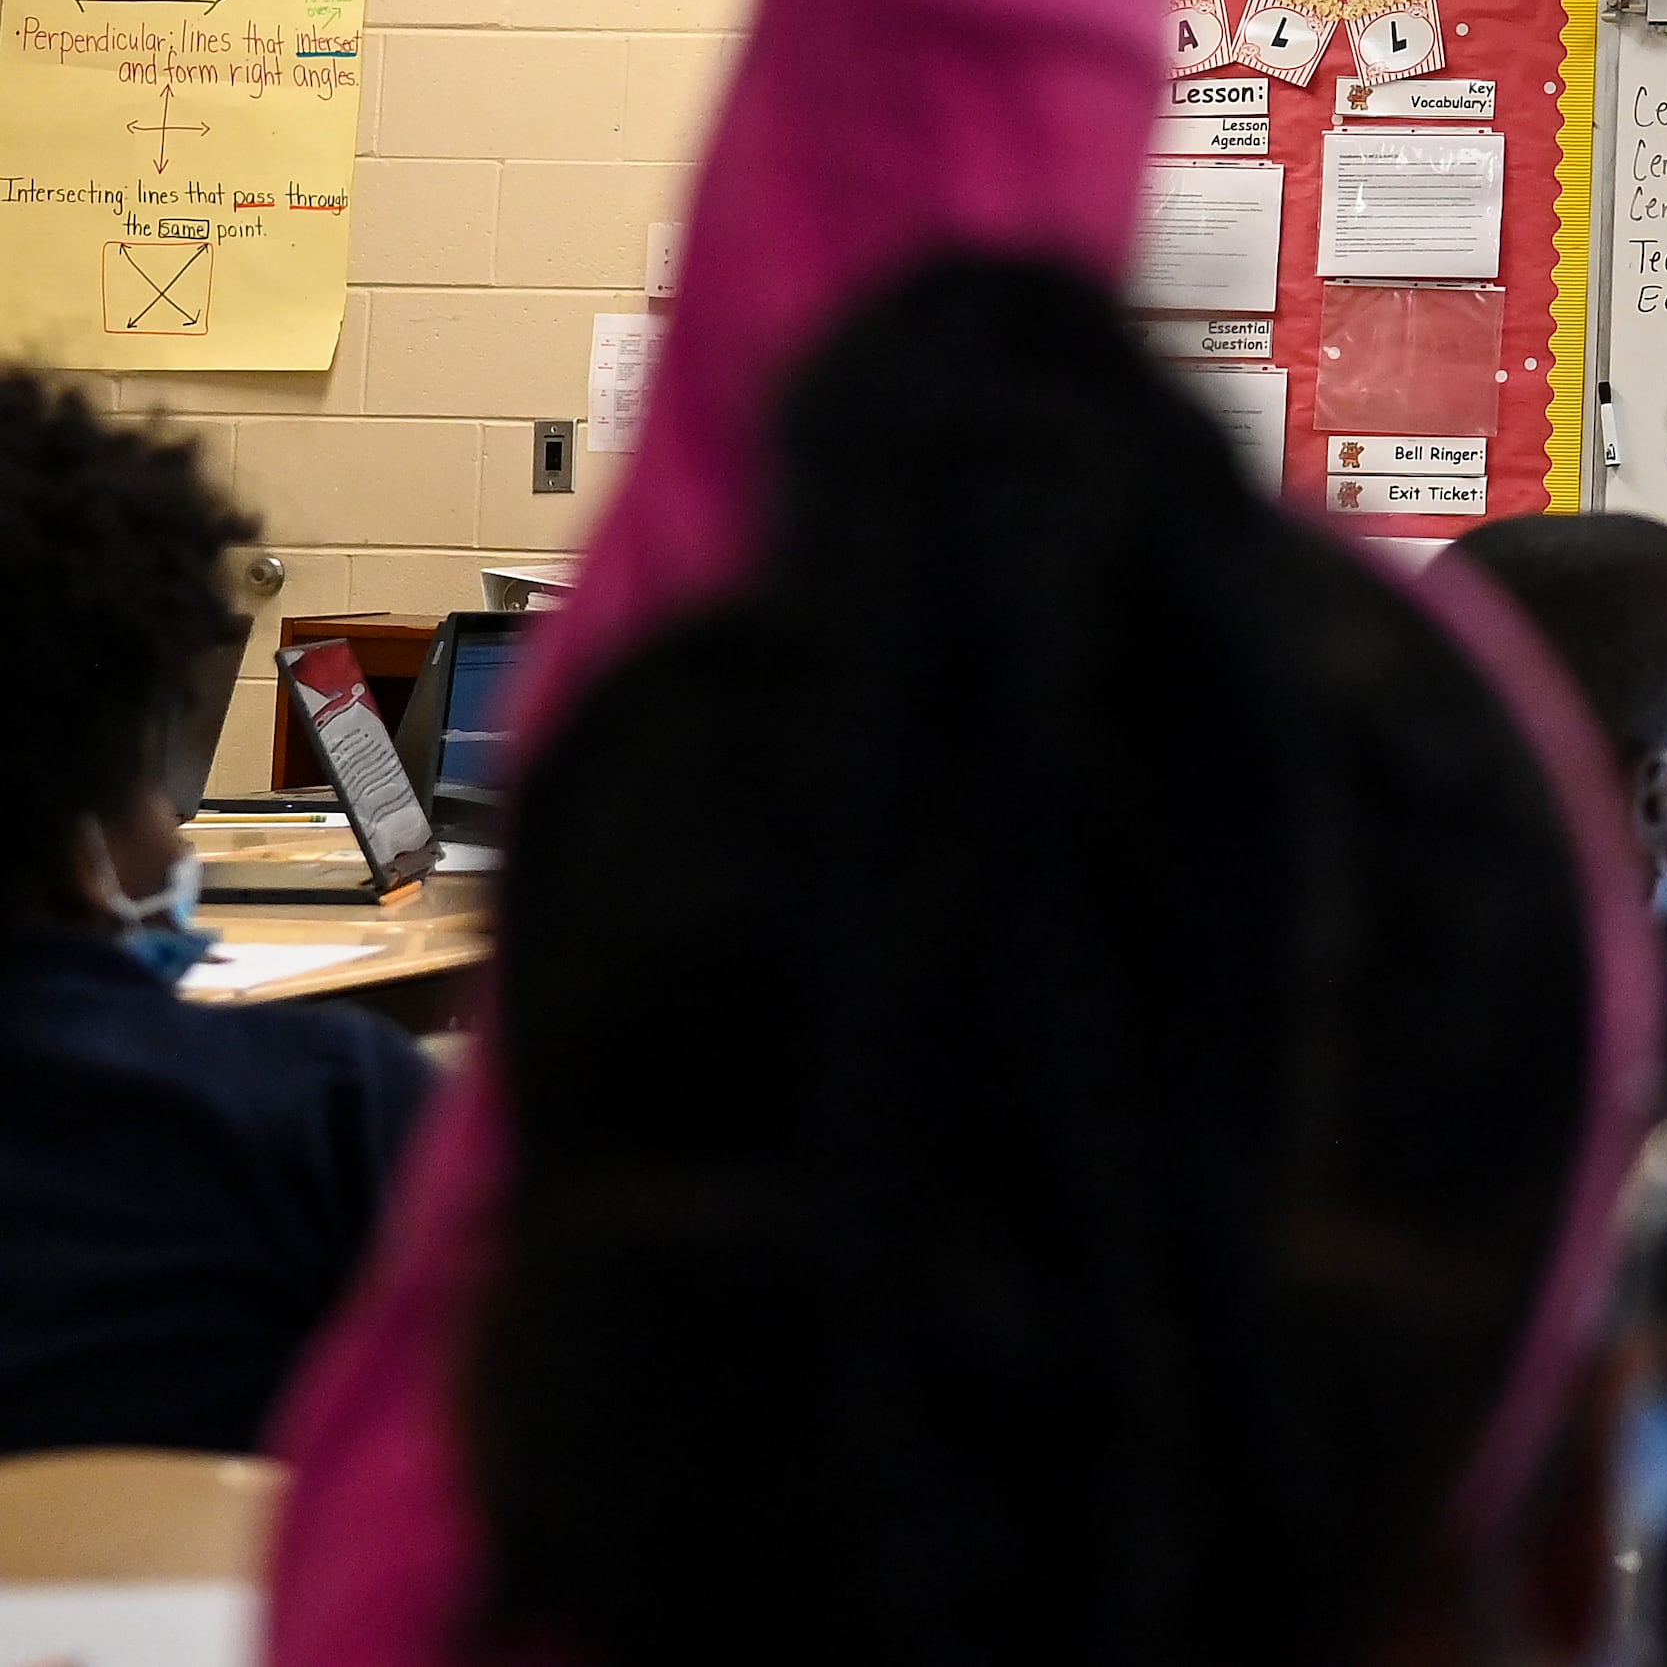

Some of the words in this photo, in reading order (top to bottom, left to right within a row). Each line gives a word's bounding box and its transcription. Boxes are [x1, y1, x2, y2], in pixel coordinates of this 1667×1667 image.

[22, 16, 174, 63] Perpendicular:
[181, 19, 231, 54] lines
[243, 20, 285, 54] that
[296, 24, 362, 57] intersect
[1178, 19, 1199, 53] A
[1271, 16, 1288, 48] L
[1390, 20, 1406, 52] L
[119, 54, 157, 84] and
[164, 50, 218, 84] form
[231, 57, 282, 99] right
[293, 59, 360, 100] angles.
[1172, 83, 1264, 104] Lesson:
[1468, 83, 1494, 98] Key
[1411, 96, 1493, 112] Vocabulary:
[1222, 120, 1268, 132] Lesson
[1211, 135, 1266, 149] Agenda:
[0, 177, 128, 216] Intersecting:
[138, 179, 179, 205] lines
[185, 182, 225, 205] that
[233, 190, 276, 212] pass
[285, 181, 348, 216] through
[123, 212, 151, 237] the
[161, 220, 206, 238] same
[217, 216, 267, 245] point.
[1208, 321, 1270, 335] Essential
[1201, 338, 1269, 354] Question:
[1394, 445, 1426, 462] Bell
[1431, 446, 1484, 467] Ringer:
[1388, 484, 1422, 501] Exit
[1428, 485, 1484, 503] Ticket:
